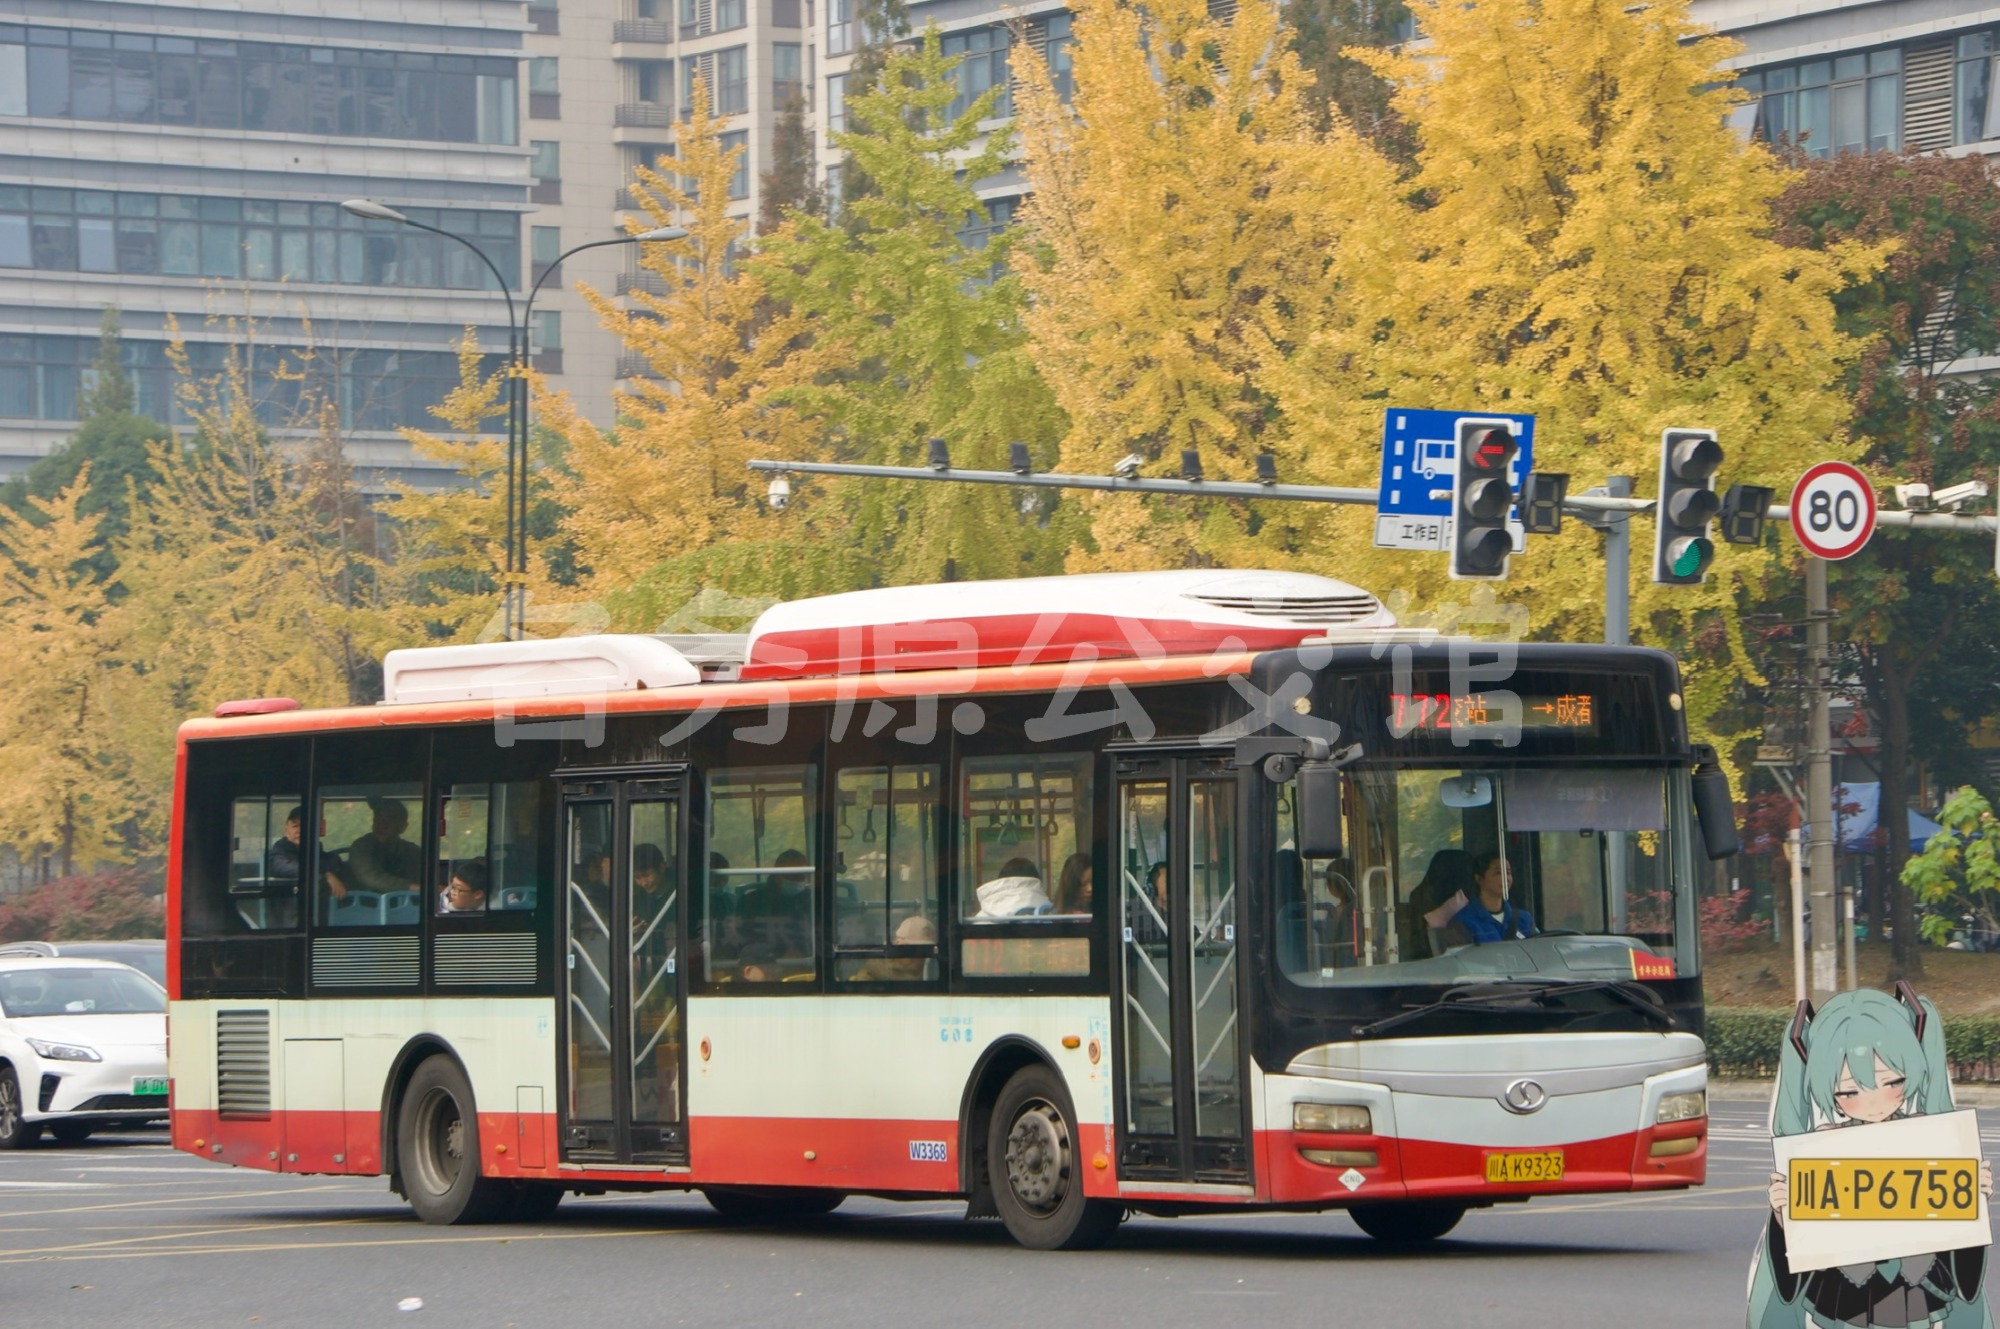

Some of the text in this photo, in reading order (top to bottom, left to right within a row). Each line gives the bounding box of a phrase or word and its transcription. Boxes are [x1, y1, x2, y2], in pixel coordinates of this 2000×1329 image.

[1809, 489, 1860, 532] 80
[1401, 523, 1439, 542] 工作日
[1389, 693, 1451, 730] 772
[910, 1142, 946, 1161] W3368
